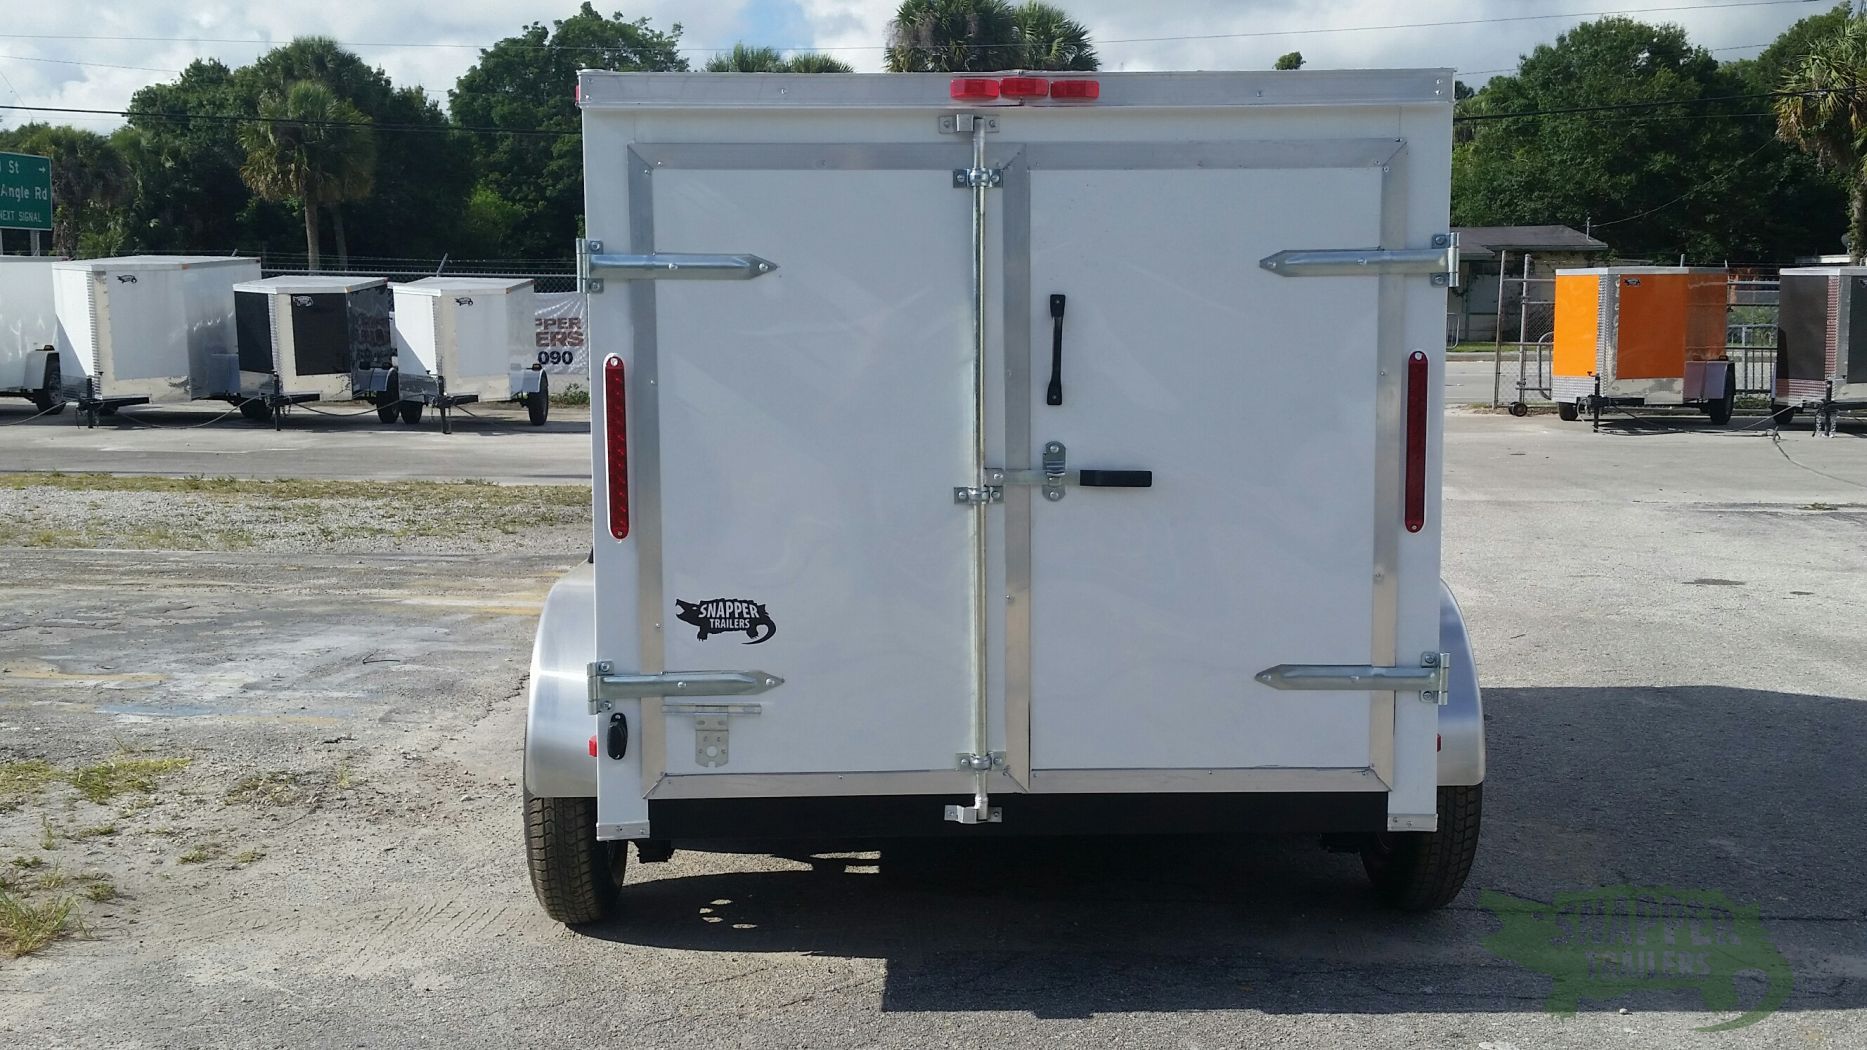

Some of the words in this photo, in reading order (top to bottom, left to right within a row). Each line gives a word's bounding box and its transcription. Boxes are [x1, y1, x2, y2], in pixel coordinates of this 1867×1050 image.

[8, 159, 20, 174] St
[0, 184, 30, 202] Angle
[34, 186, 48, 200] Rd
[18, 211, 42, 222] SIGNAL
[535, 331, 584, 347] ERS
[537, 350, 574, 365] 090
[698, 601, 760, 618] SNAPPER
[709, 619, 750, 629] TRAILERS
